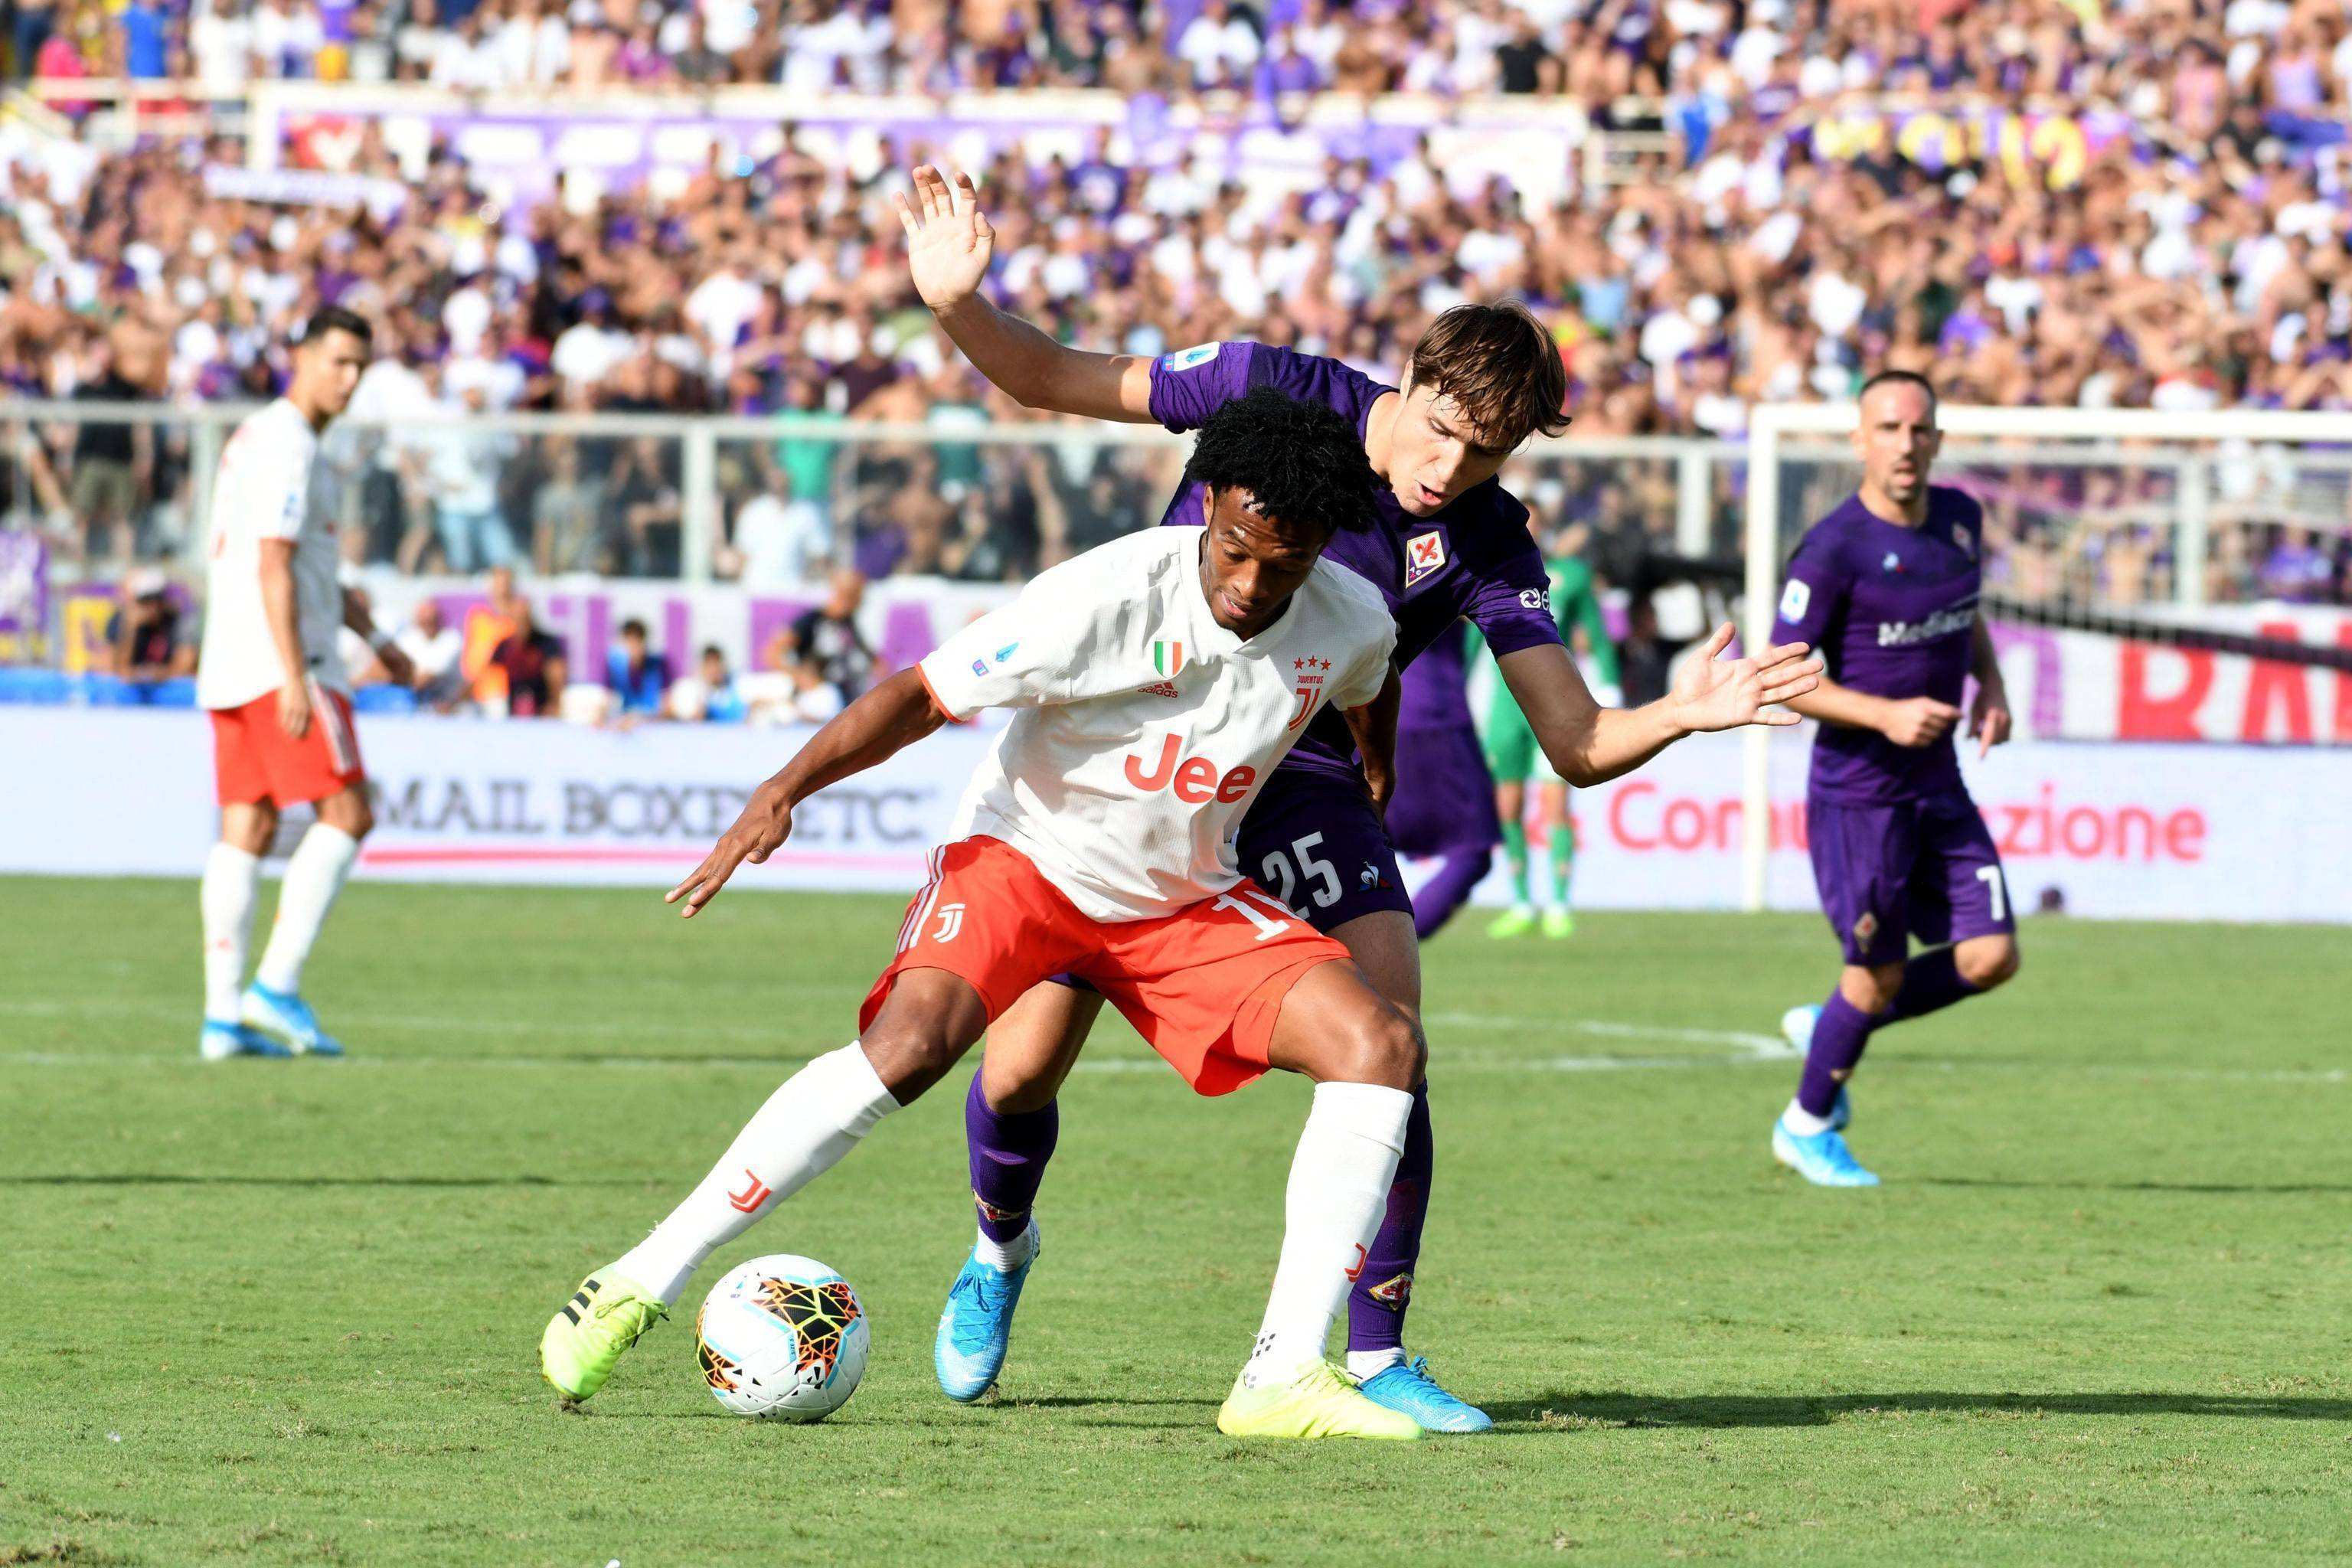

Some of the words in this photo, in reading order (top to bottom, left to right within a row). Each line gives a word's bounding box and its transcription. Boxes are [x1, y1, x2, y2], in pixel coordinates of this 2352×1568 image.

[1138, 685, 1178, 698] adidas
[1297, 675, 1324, 684] JUVENTUS
[1125, 733, 1256, 803] Jee
[366, 779, 544, 834] MAIL
[564, 782, 754, 837] BOXE
[1263, 831, 1342, 920] 25
